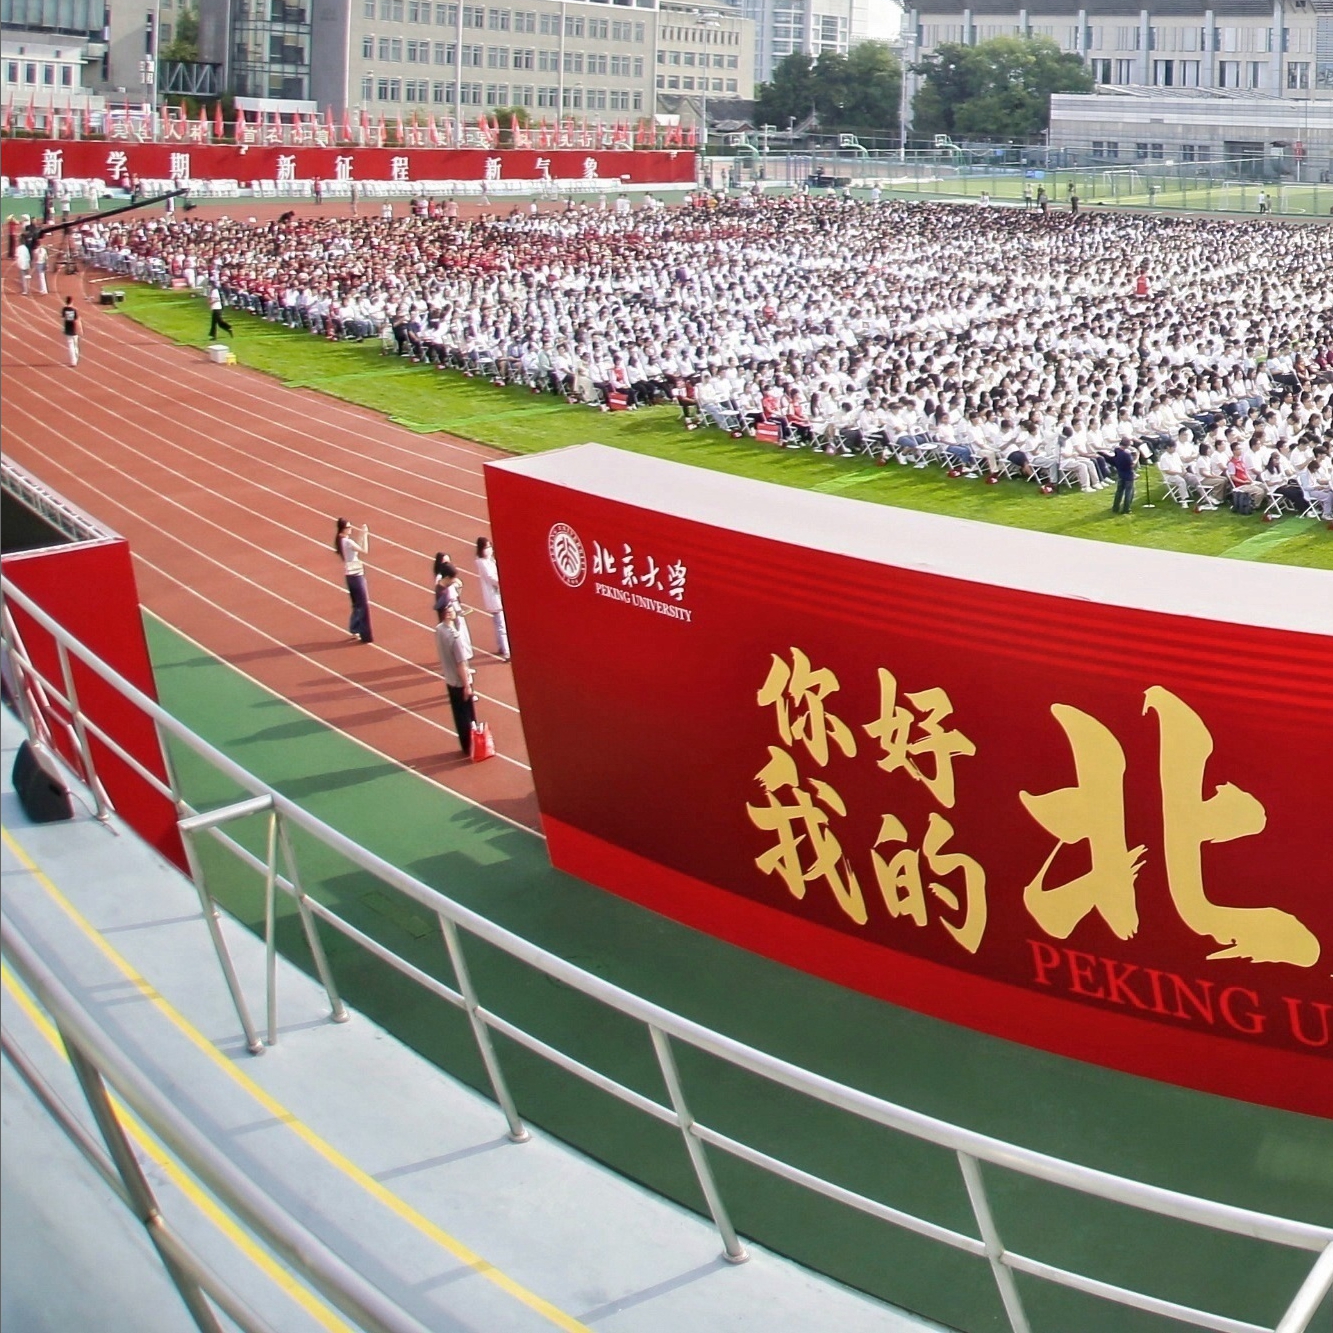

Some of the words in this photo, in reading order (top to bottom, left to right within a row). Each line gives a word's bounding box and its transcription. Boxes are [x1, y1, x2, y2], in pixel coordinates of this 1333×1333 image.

[592, 539, 688, 601] 北京大学
[595, 582, 631, 604] PEKING
[631, 593, 692, 622] UNIVERSITY
[757, 647, 977, 807] 你好
[746, 747, 988, 954] 我的
[1026, 939, 1267, 1034] PEKING
